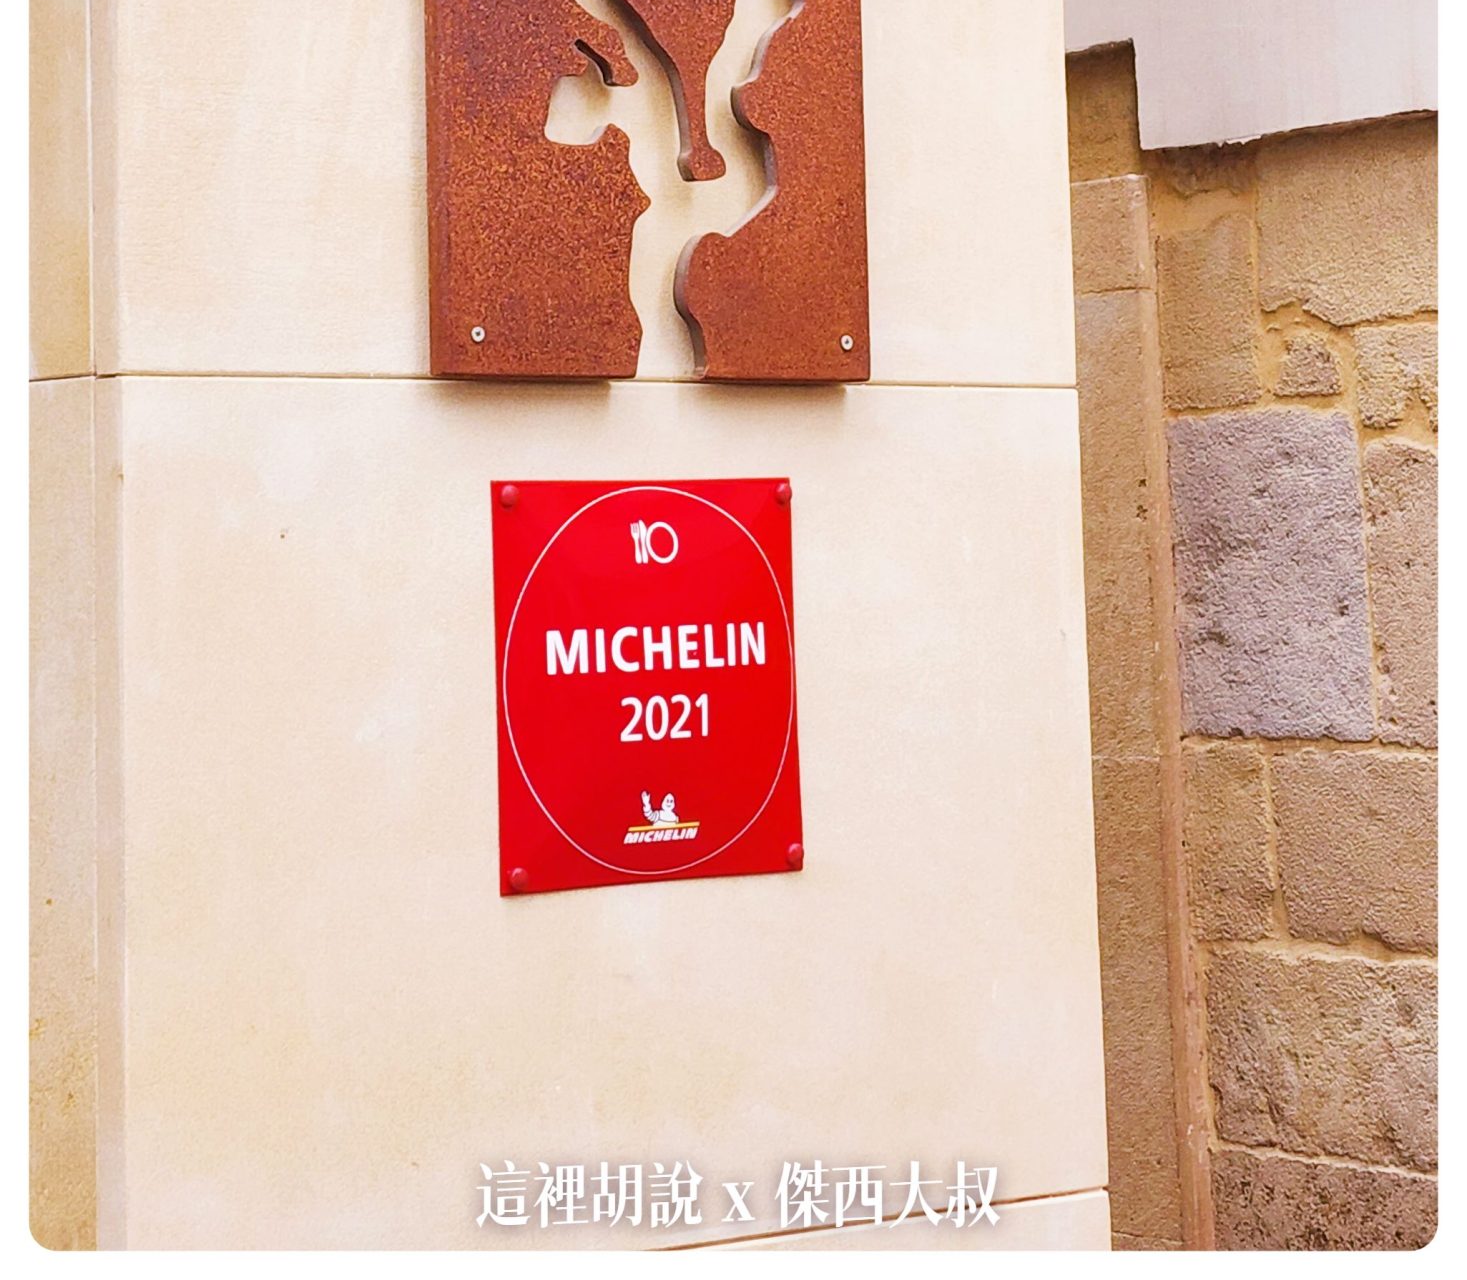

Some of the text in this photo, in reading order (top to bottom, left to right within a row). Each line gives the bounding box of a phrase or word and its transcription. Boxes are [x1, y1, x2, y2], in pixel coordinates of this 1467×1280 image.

[545, 620, 766, 676] MICHELIN
[619, 693, 709, 743] 2021
[623, 826, 700, 845] MICHELIN
